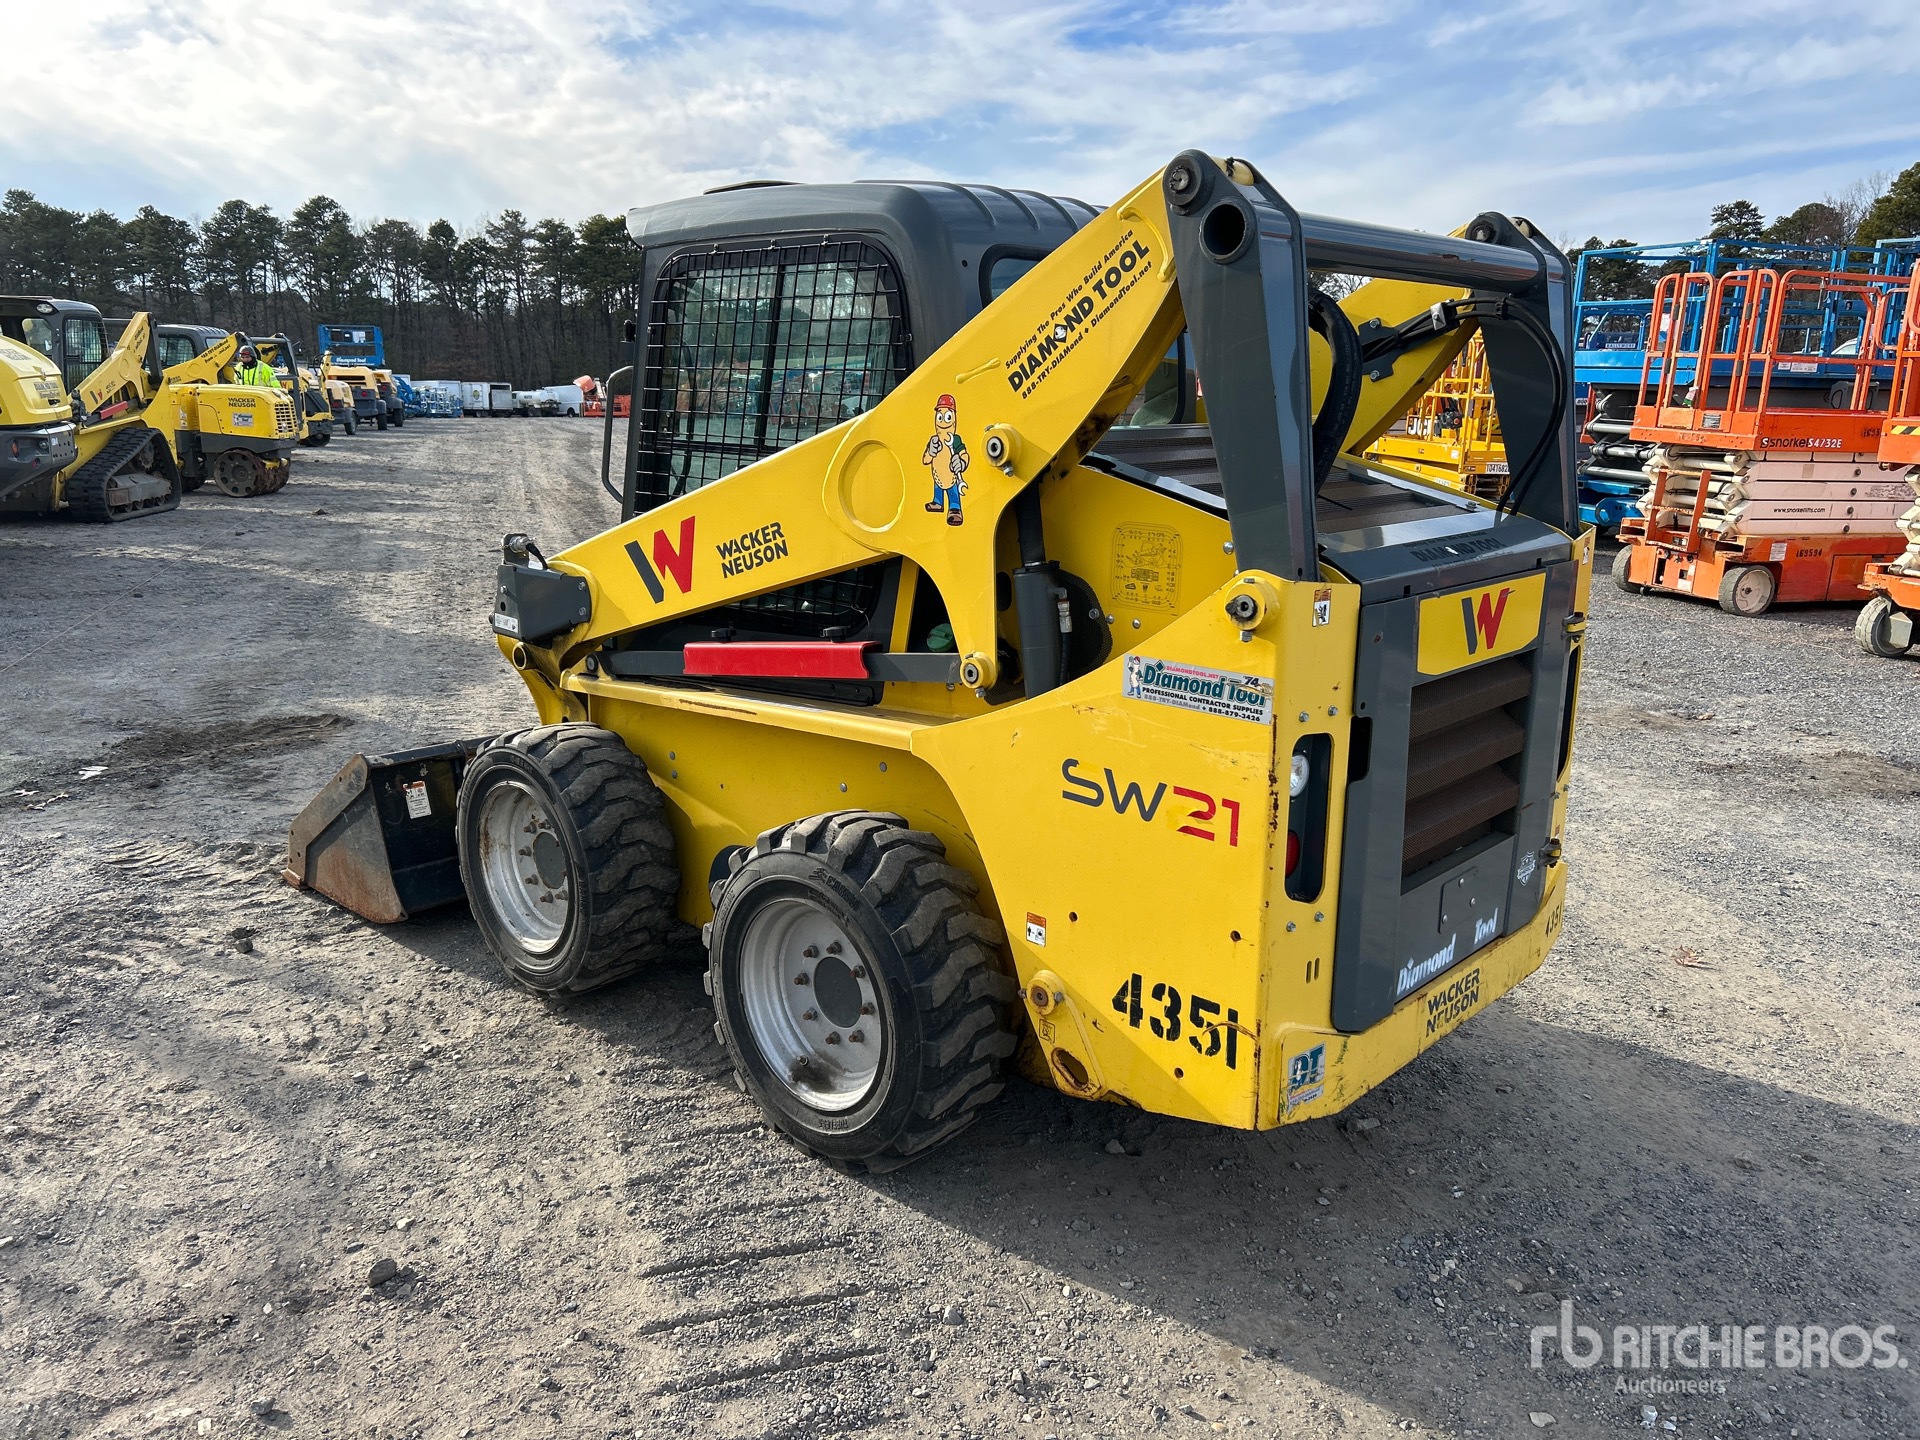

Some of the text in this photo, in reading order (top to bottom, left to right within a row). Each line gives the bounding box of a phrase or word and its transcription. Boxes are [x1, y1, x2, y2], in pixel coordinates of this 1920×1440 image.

[1092, 240, 1150, 300] TOOL
[1005, 229, 1133, 369] Supplying The Pros Who Build America
[1022, 260, 1152, 400] 888-TRY-DIAMond DiamondTool.net
[1769, 437, 1808, 448] snorkel
[715, 521, 785, 560] WACKER
[721, 539, 789, 579] NEUSON
[1142, 659, 1227, 700] Diamond
[1228, 678, 1267, 707] Tool
[1166, 665, 1219, 679] DIAMONDTOOL.NET
[1142, 687, 1264, 716] PROFESSIONAL CONTRACTOR SUPPLIES
[1208, 706, 1261, 722] 888-879-3426
[1062, 758, 1241, 848] SW21
[1545, 901, 1563, 938] 4351
[1396, 907, 1499, 996] Diamond Tool
[1425, 986, 1480, 1038] NEUSON
[1427, 967, 1480, 1016] WACKER
[1111, 972, 1239, 1071] 4351
